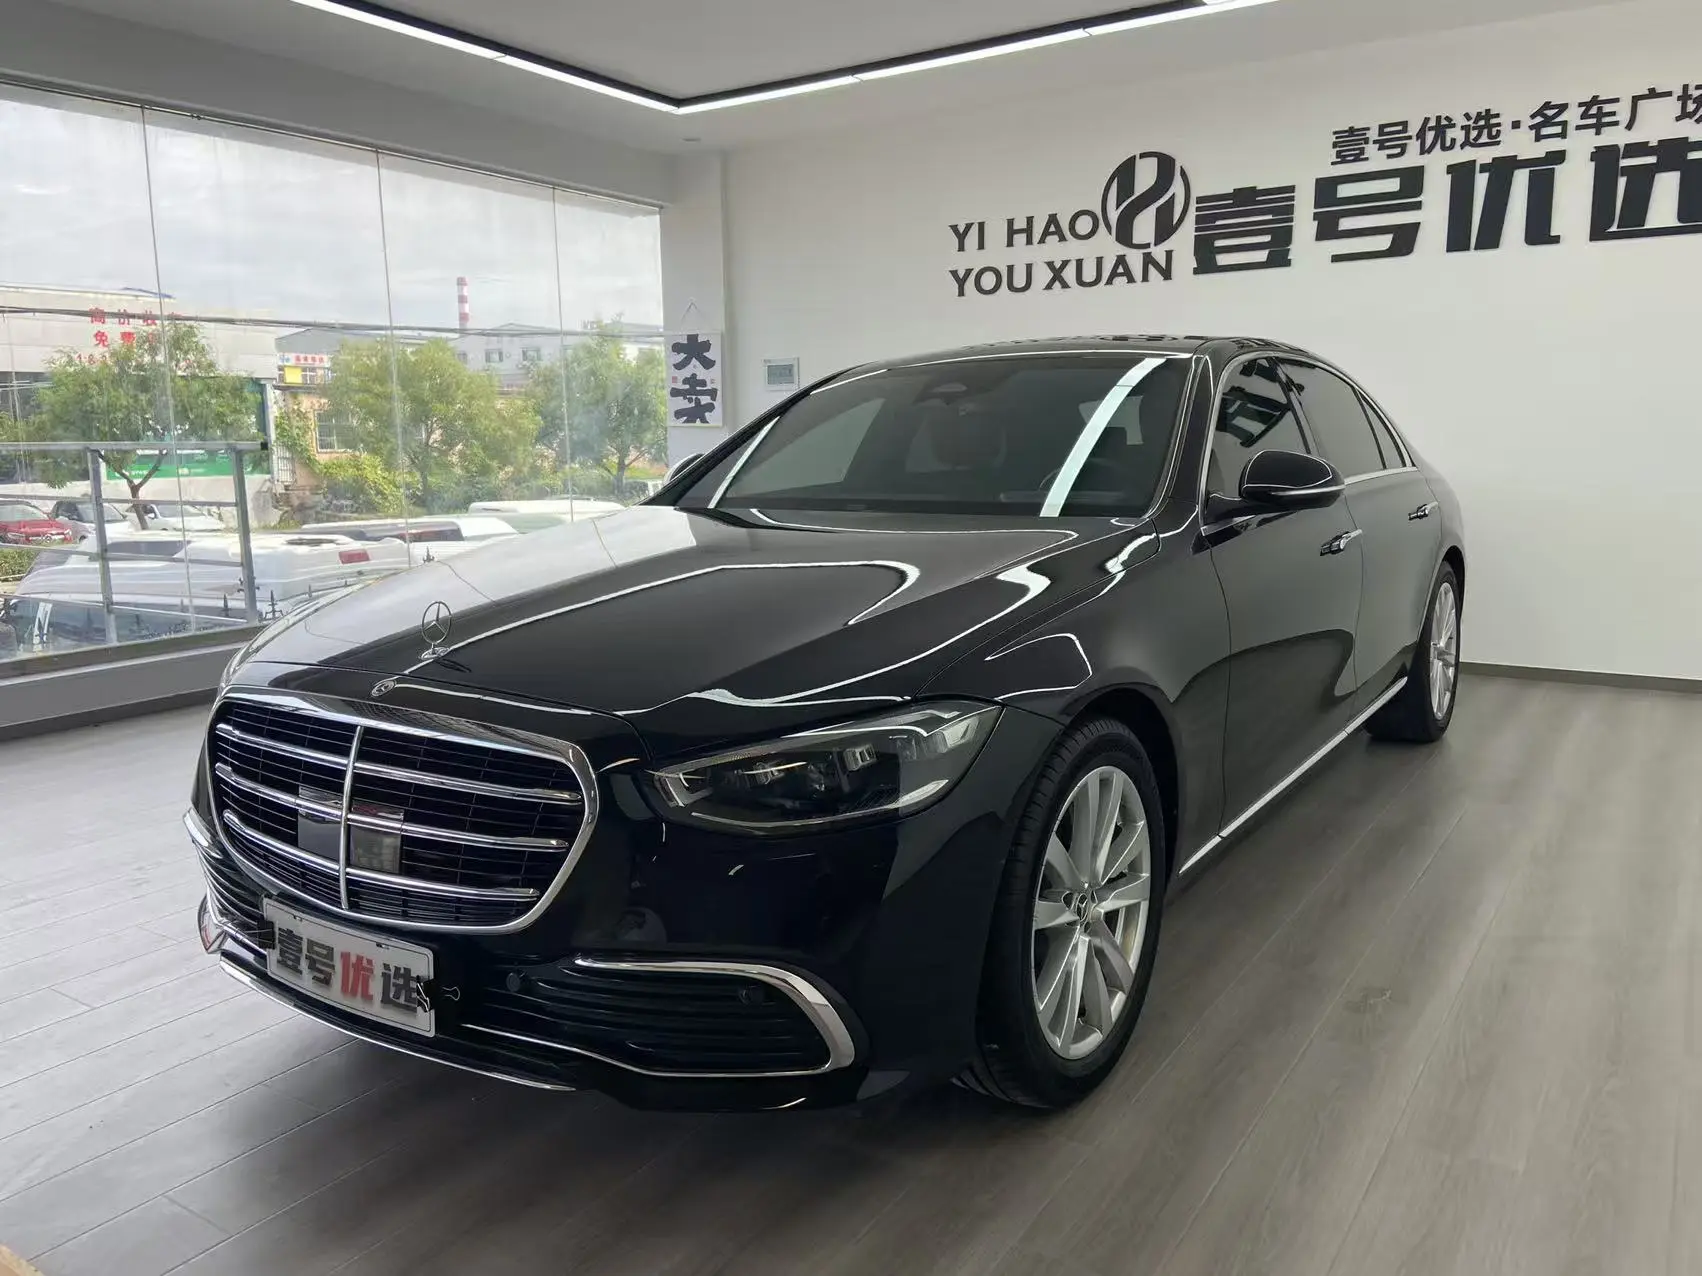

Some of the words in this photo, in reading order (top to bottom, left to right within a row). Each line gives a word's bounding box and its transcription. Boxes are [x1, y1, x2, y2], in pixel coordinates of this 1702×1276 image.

[948, 221, 986, 252] YI
[1006, 209, 1100, 249] HAO
[1192, 136, 1702, 275] 壹号优选
[948, 262, 1034, 297] YOU
[1042, 249, 1175, 290] XUAN
[276, 927, 418, 1014] 壹号优选
